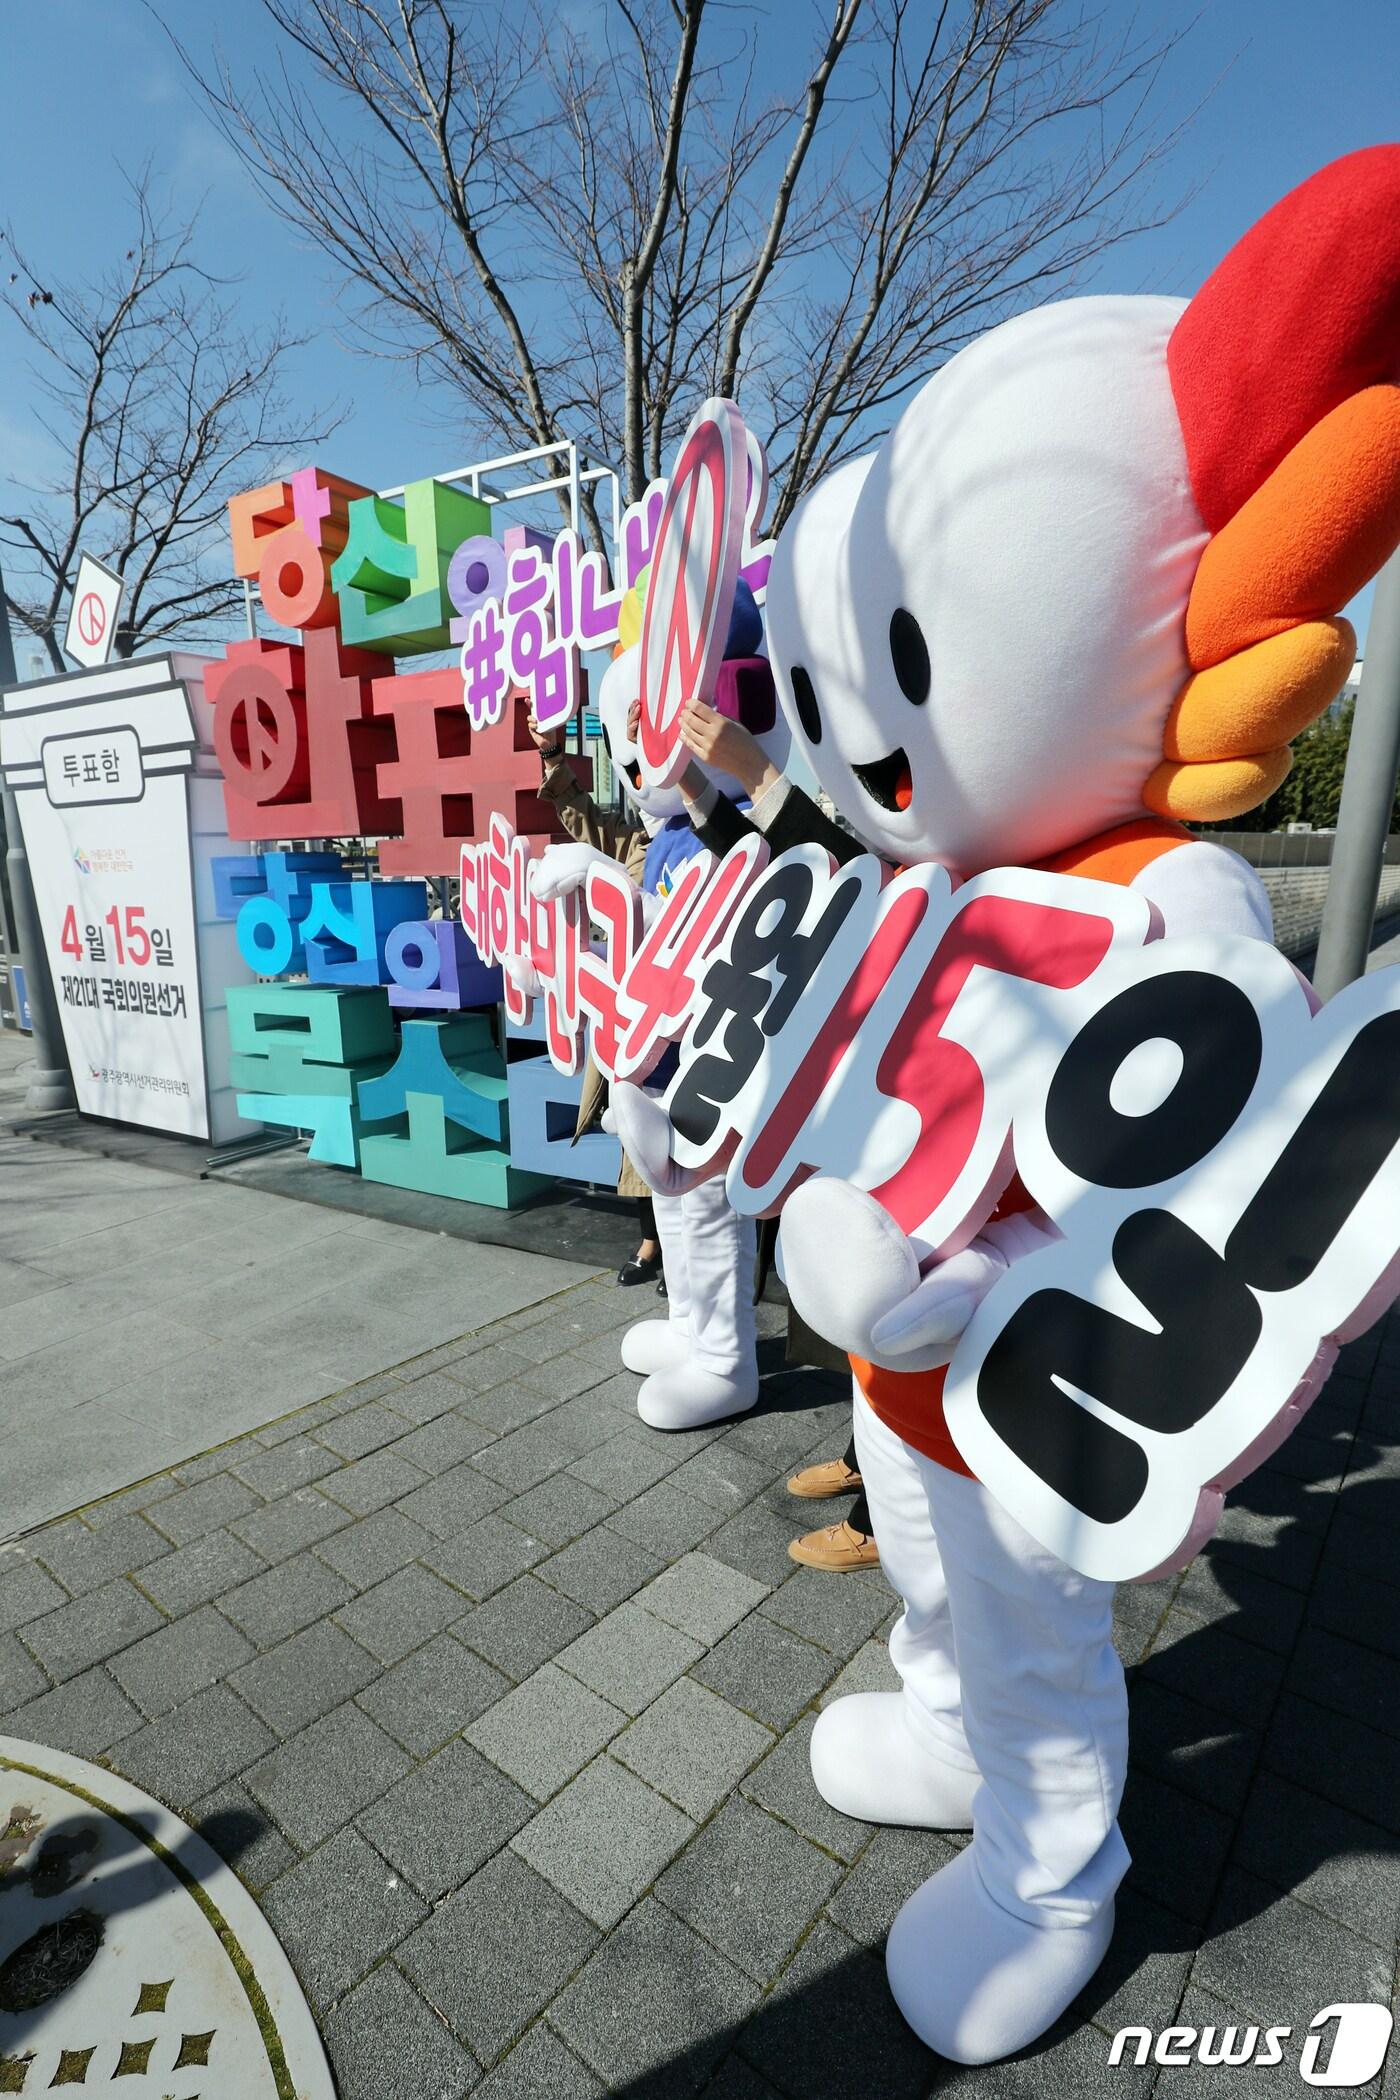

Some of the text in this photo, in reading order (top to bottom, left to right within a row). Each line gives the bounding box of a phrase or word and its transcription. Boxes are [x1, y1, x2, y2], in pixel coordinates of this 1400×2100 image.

[63, 748, 120, 787] 투표함
[211, 852, 461, 1009] 당신의
[462, 830, 632, 1078] 대한민국
[61, 975, 188, 1019] 제21대 국회의원선거
[101, 1067, 191, 1097] 광주광역시선거관리위원회
